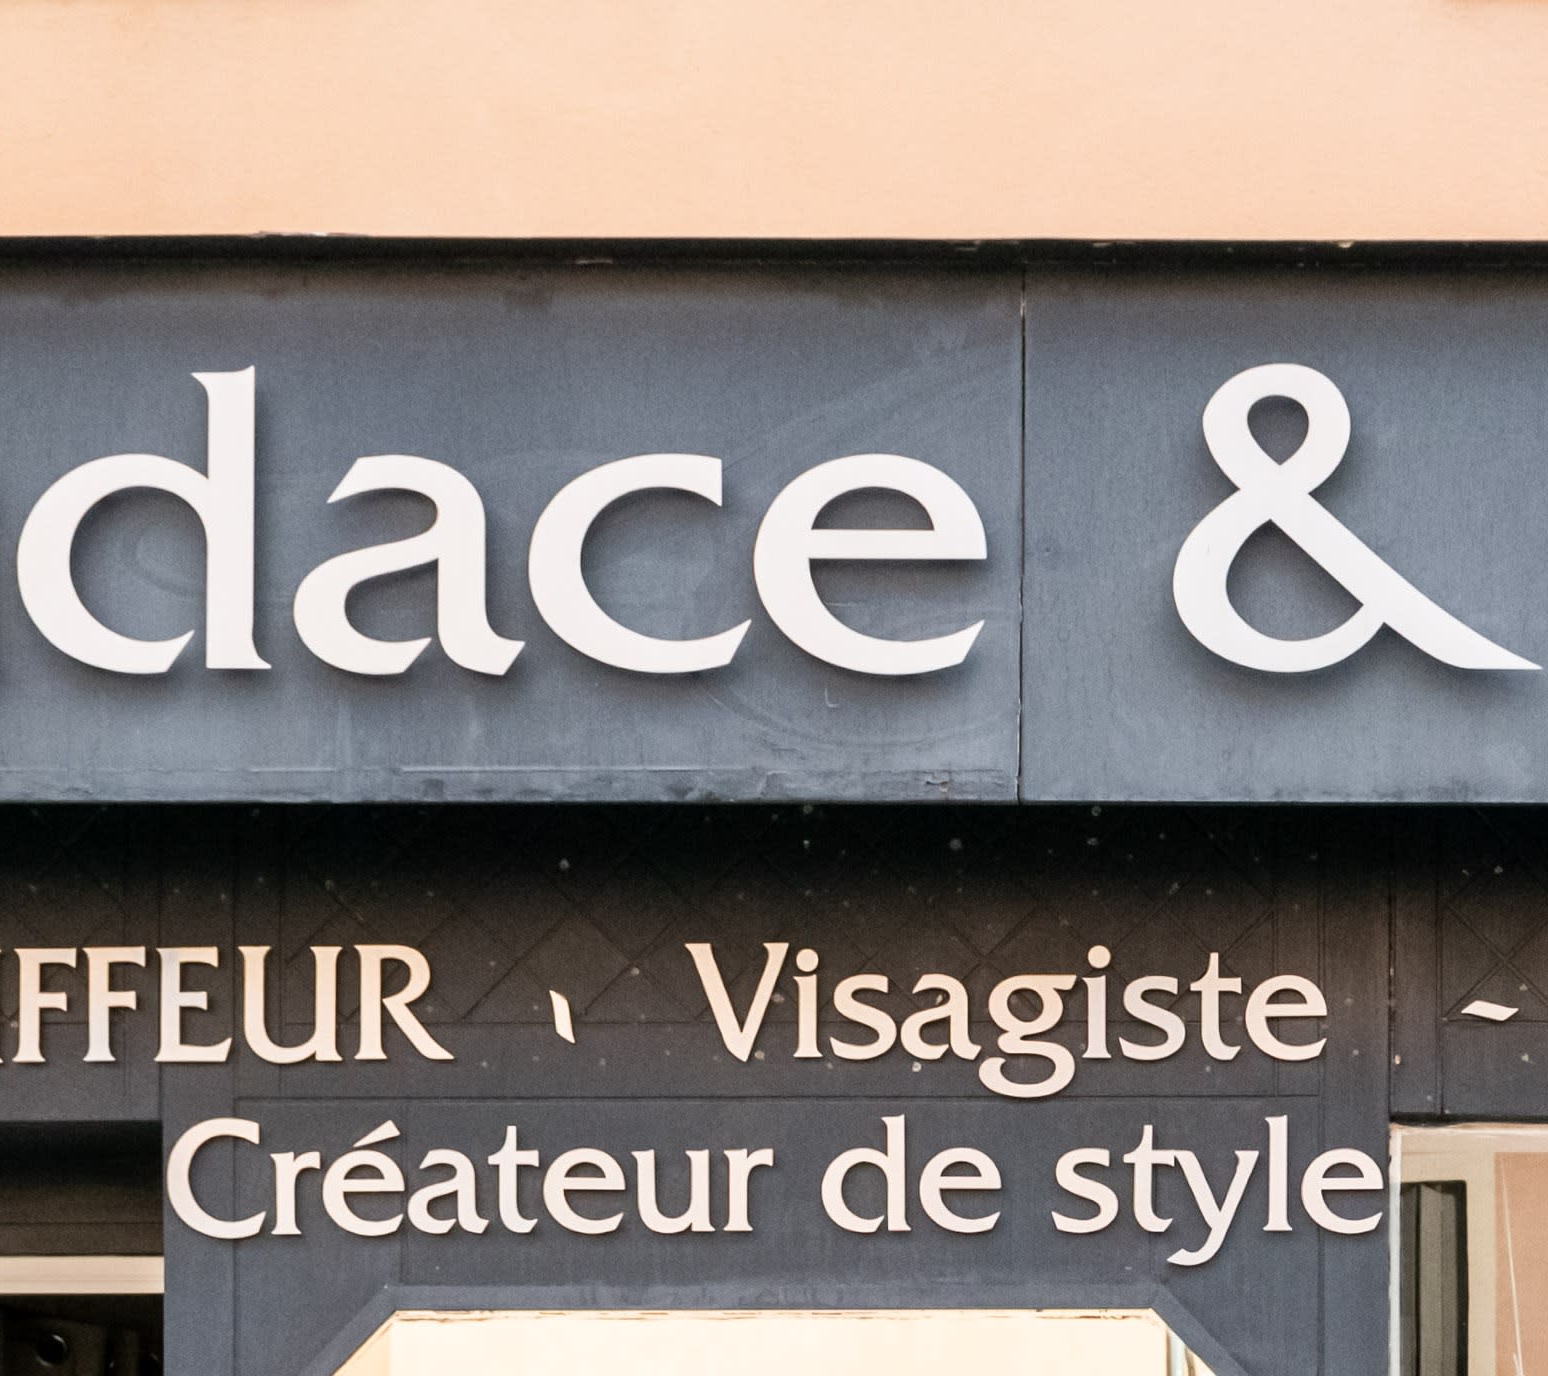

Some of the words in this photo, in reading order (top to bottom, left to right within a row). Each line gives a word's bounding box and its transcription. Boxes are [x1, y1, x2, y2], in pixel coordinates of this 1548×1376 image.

[1173, 363, 1543, 674] &
[685, 942, 1329, 1098] Visagiste
[166, 1117, 775, 1240] Créateur
[821, 1114, 1002, 1234] de
[1051, 1114, 1388, 1267] style
